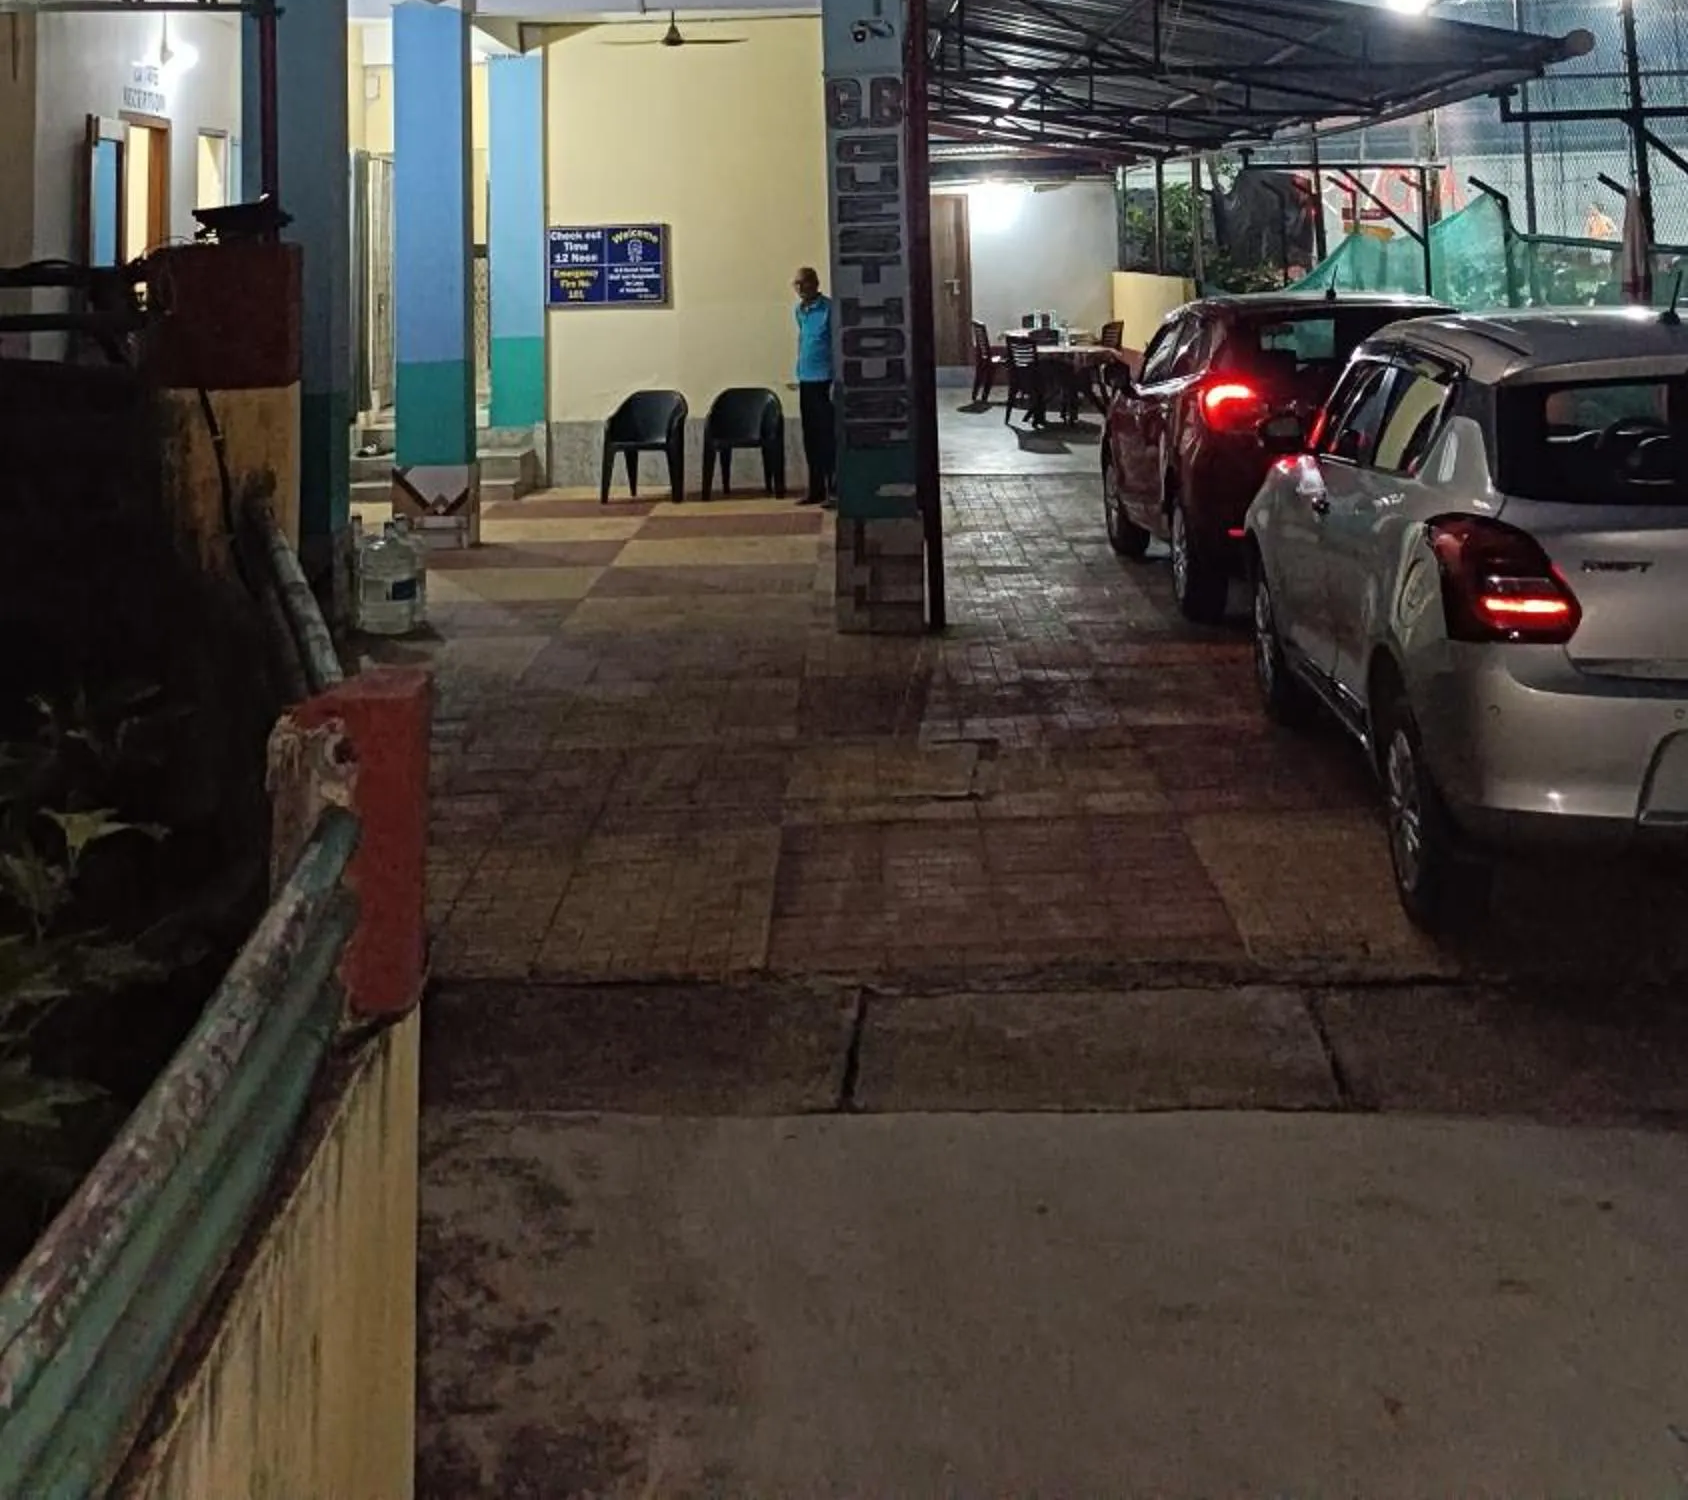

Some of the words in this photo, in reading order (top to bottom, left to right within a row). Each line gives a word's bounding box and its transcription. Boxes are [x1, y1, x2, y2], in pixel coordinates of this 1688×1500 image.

[836, 134, 901, 284] GUEST
[550, 231, 582, 241] Check
[585, 231, 602, 240] out
[611, 229, 659, 244] Welcome
[563, 241, 589, 252] Time
[554, 253, 569, 263] 12
